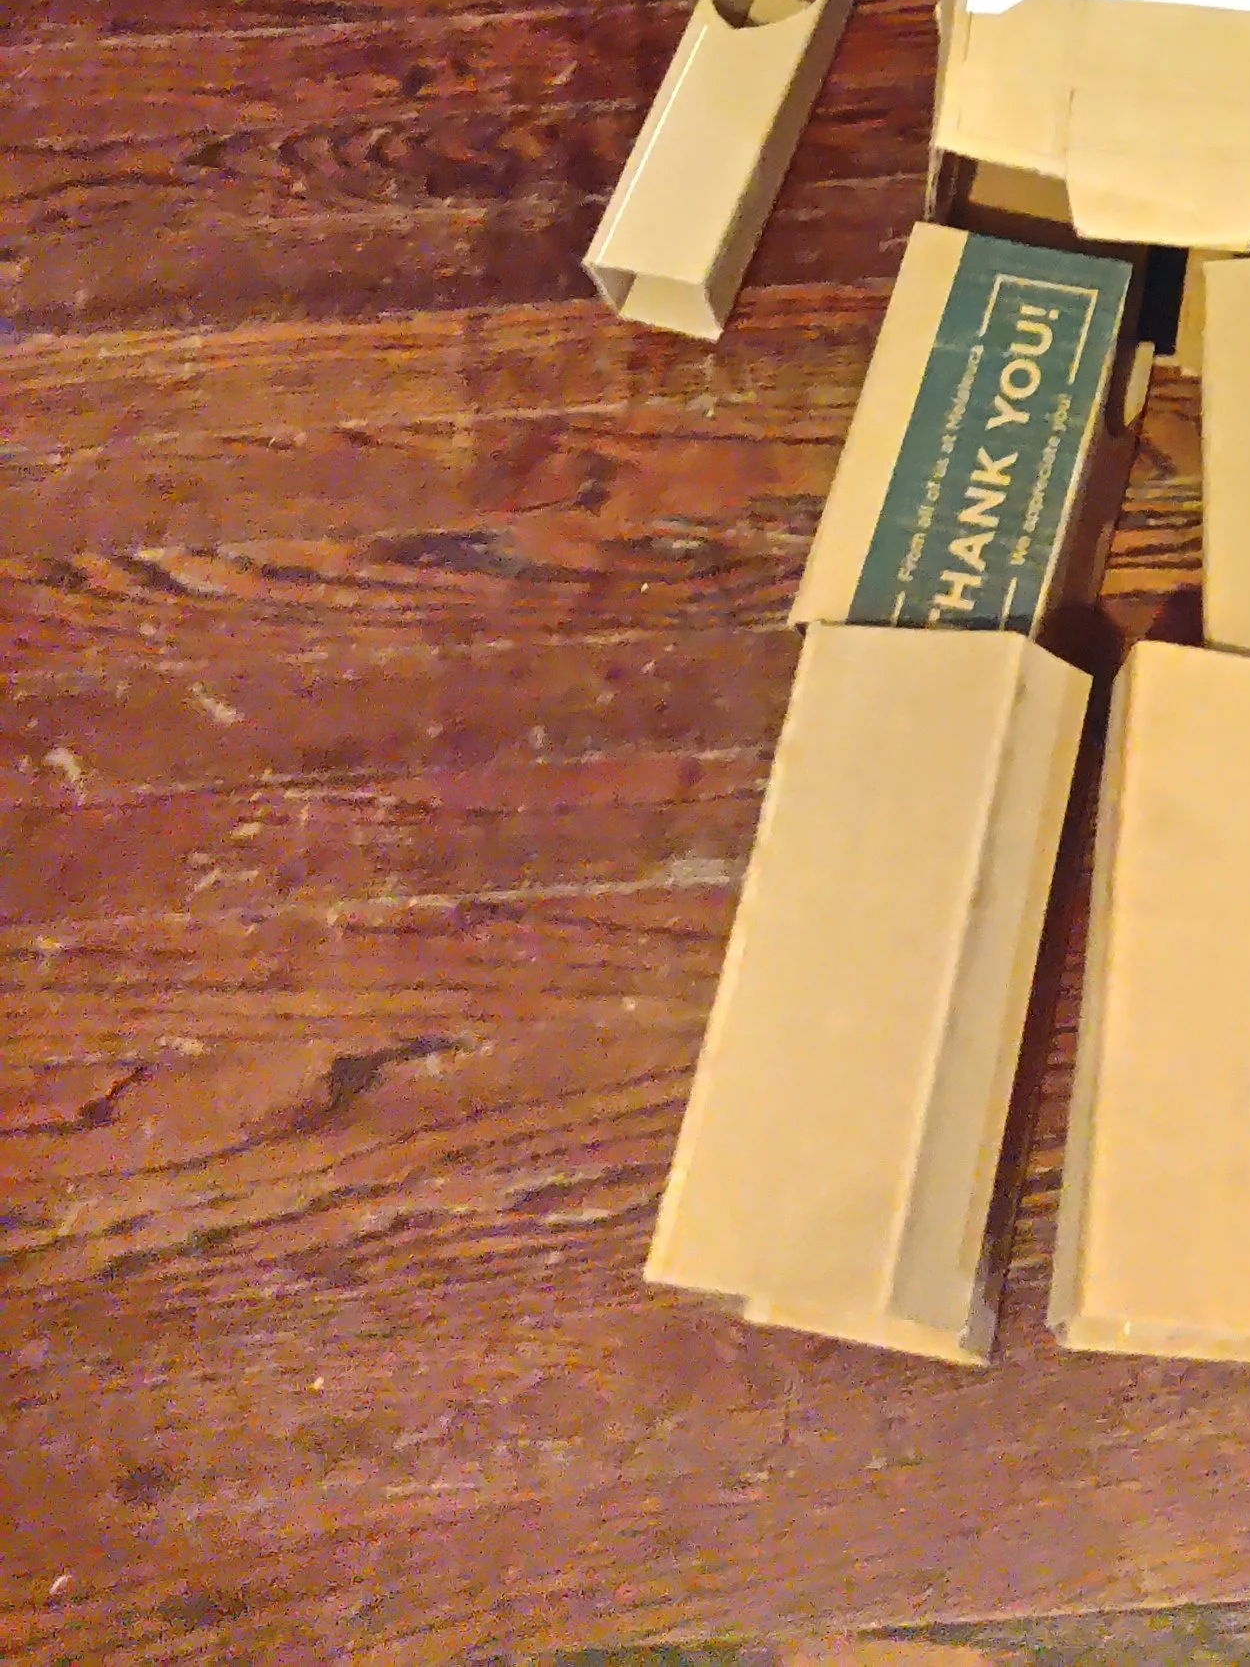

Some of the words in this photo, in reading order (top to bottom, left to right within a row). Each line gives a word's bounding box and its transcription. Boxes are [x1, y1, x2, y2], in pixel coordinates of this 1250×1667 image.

[984, 303, 1061, 431] YOU!
[941, 434, 957, 454] at
[933, 458, 950, 479] us
[926, 481, 941, 502] of
[1008, 535, 1032, 566] We
[1022, 435, 1062, 534] appreciate
[917, 505, 935, 529] all
[897, 533, 926, 582] From
